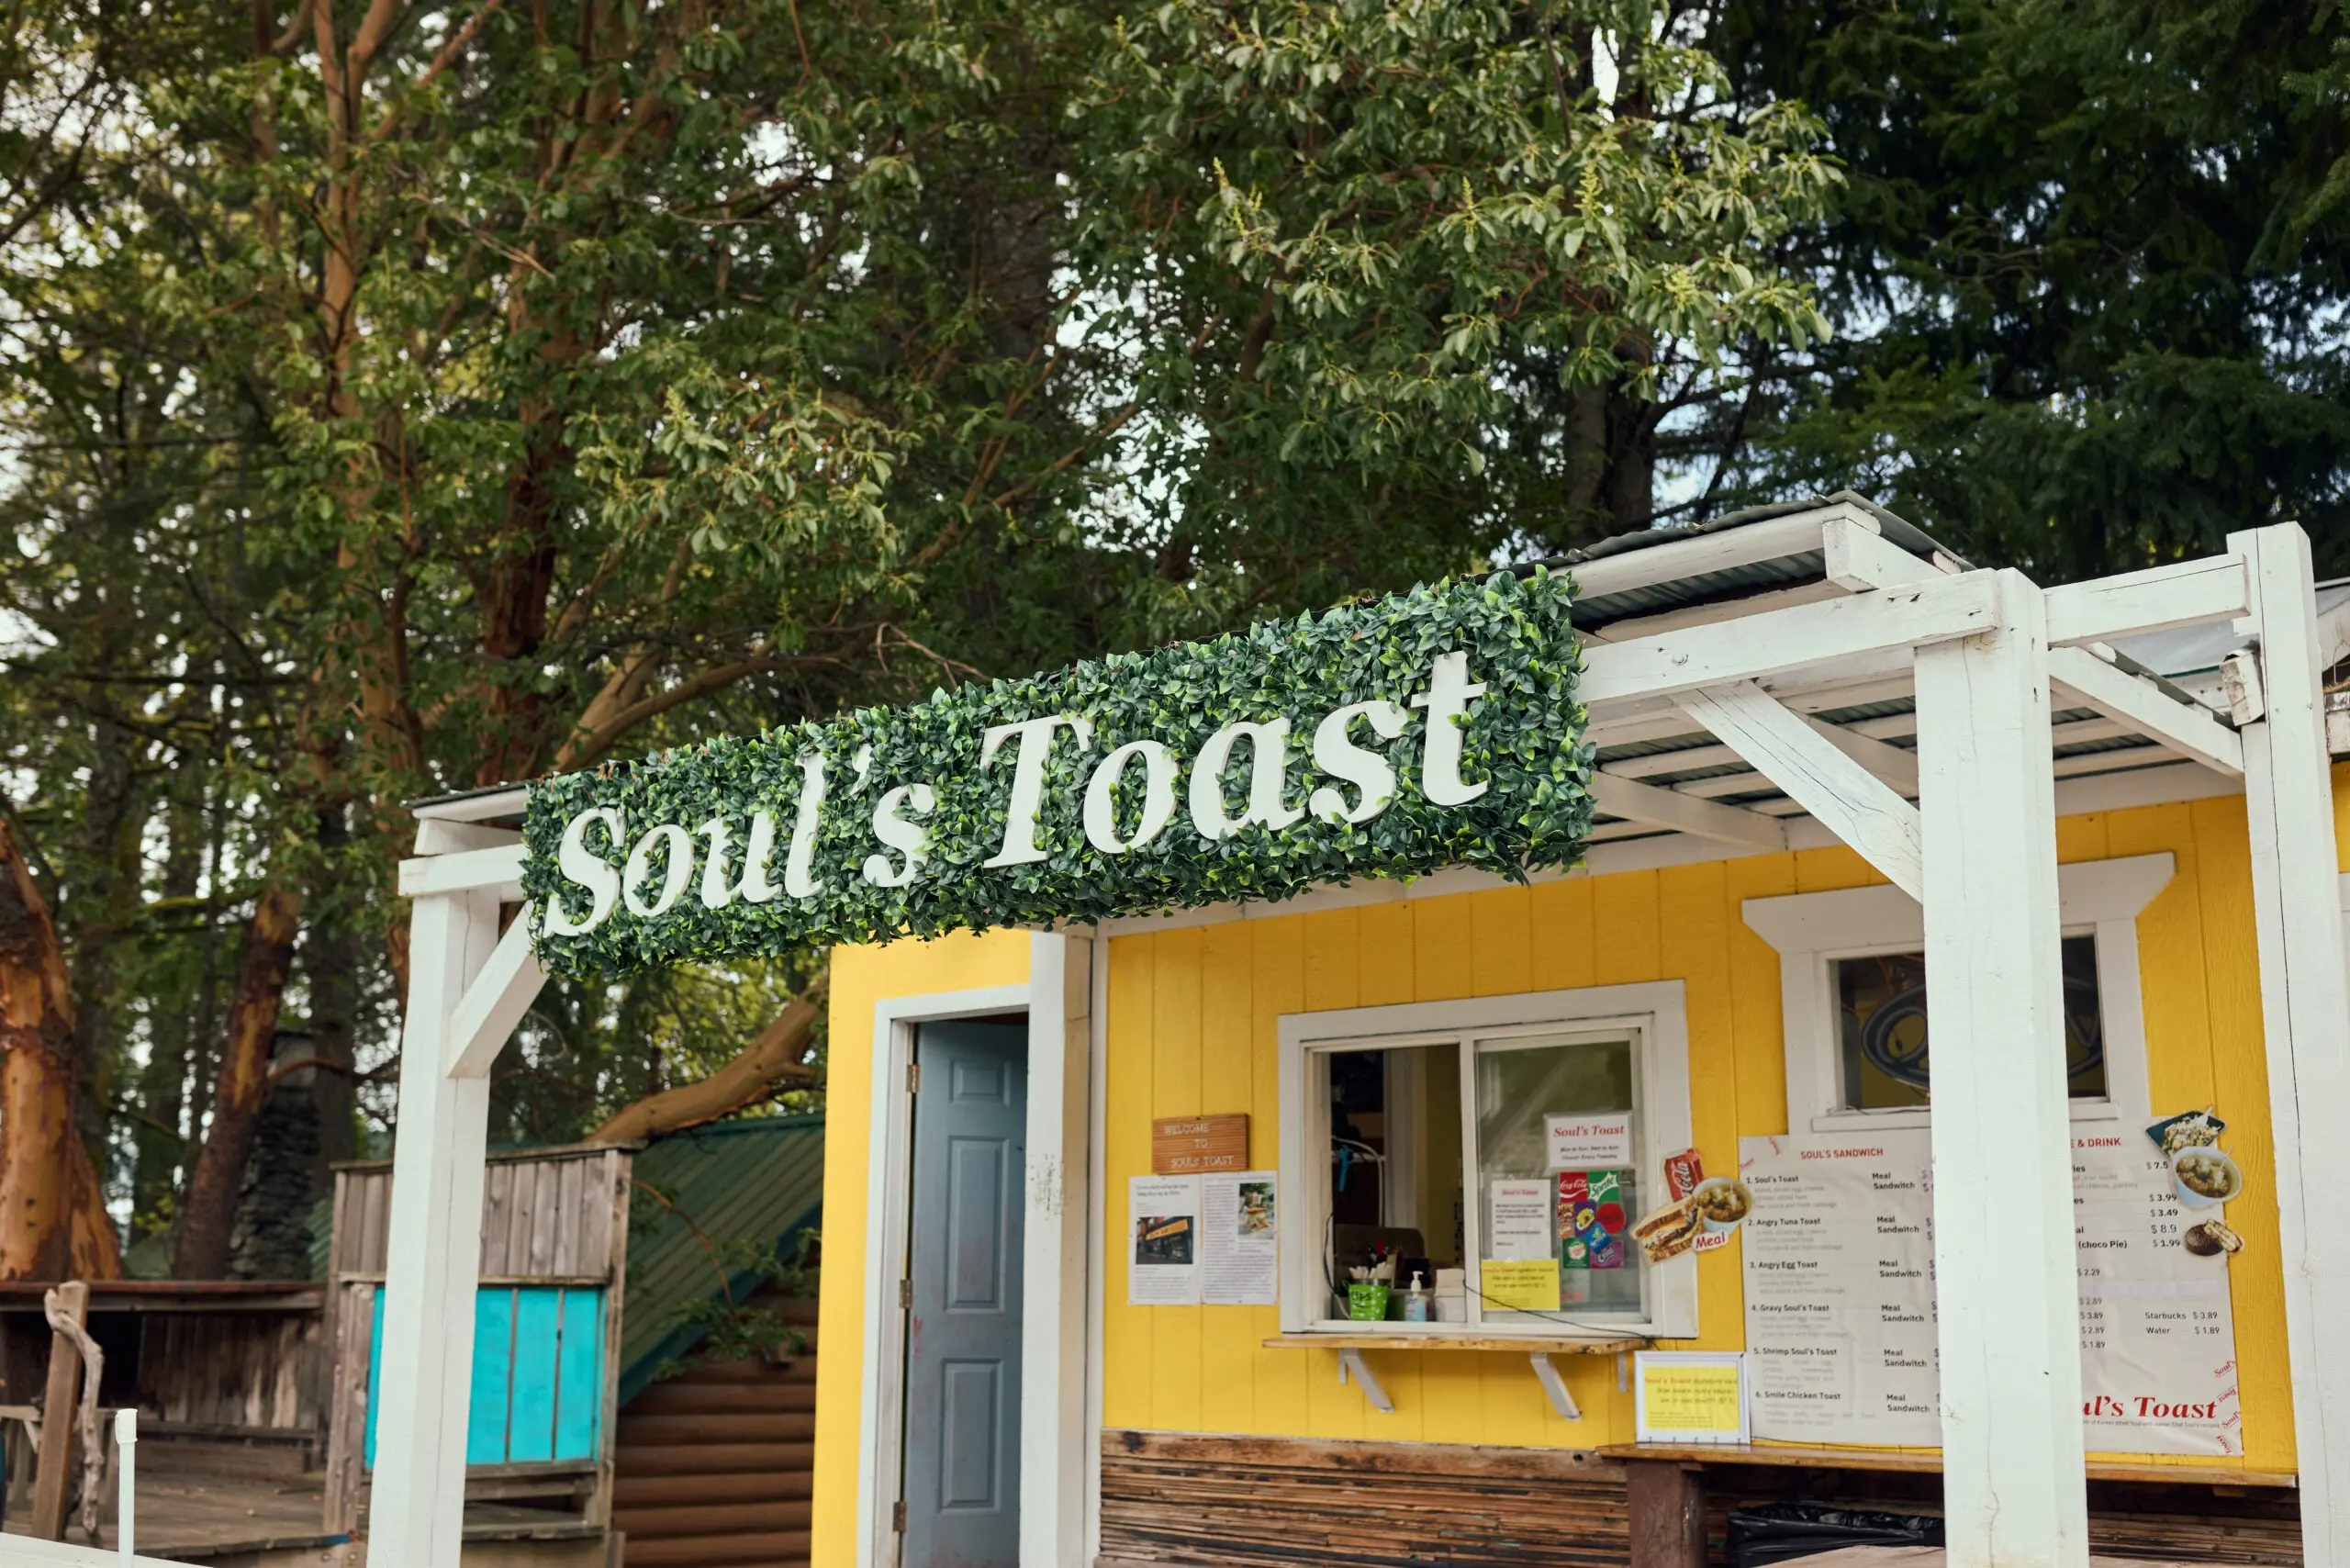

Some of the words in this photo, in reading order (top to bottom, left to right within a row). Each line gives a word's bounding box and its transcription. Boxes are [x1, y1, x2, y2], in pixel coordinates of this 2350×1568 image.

[544, 742, 936, 938] Soul's
[981, 650, 1489, 869] Toast
[1164, 1123, 1210, 1136] WELCOME
[1553, 1126, 1589, 1137] Soul's
[1592, 1125, 1625, 1136] Toast
[1194, 1138, 1208, 1148] TO
[2077, 1138, 2085, 1148] &
[2087, 1137, 2121, 1148] DRINK
[1800, 1149, 1831, 1159] SOUL'S
[1833, 1148, 1884, 1158] SANDWICH
[1203, 1155, 1235, 1167] TOAST
[1591, 1176, 1617, 1197] Sprite
[2156, 1193, 2177, 1202] 3.99
[2157, 1208, 2178, 1217] 3.49
[1756, 1218, 1778, 1227] Angry
[1877, 1226, 1919, 1234] Sandwitch
[2160, 1224, 2177, 1234] 8.9
[1695, 1231, 1726, 1249] Meal
[2077, 1240, 2108, 1249] (choco
[2109, 1240, 2128, 1249] Pie)
[2160, 1239, 2181, 1248] 1.99
[1758, 1260, 1781, 1271] Angry
[1782, 1260, 1796, 1271] Egg
[1796, 1260, 1818, 1269] Toast
[1878, 1259, 1897, 1267] Meal
[1879, 1269, 1922, 1278] Sandwitch
[1760, 1305, 1783, 1314] Gravy
[1784, 1304, 1807, 1312] Soul's
[1808, 1304, 1830, 1312] Toast
[1882, 1315, 1925, 1323] Sandwitch
[2144, 1311, 2187, 1320] Starbucks
[2192, 1311, 2198, 1320] $
[2200, 1311, 2218, 1319] 3.89
[2194, 1327, 2199, 1335] $
[1762, 1348, 1789, 1357] Shrimp
[1816, 1348, 1838, 1356] Toast
[1884, 1349, 1903, 1357] Meal
[1885, 1359, 1927, 1368] Sandwitch
[1764, 1391, 1785, 1399] Smile
[1787, 1392, 1818, 1400] Chicken
[1819, 1392, 1841, 1400] Toast
[1886, 1394, 1906, 1402] Meal
[1887, 1405, 1930, 1413] Sandwitch
[2082, 1395, 2124, 1417] ul's
[2133, 1396, 2218, 1419] Toast
